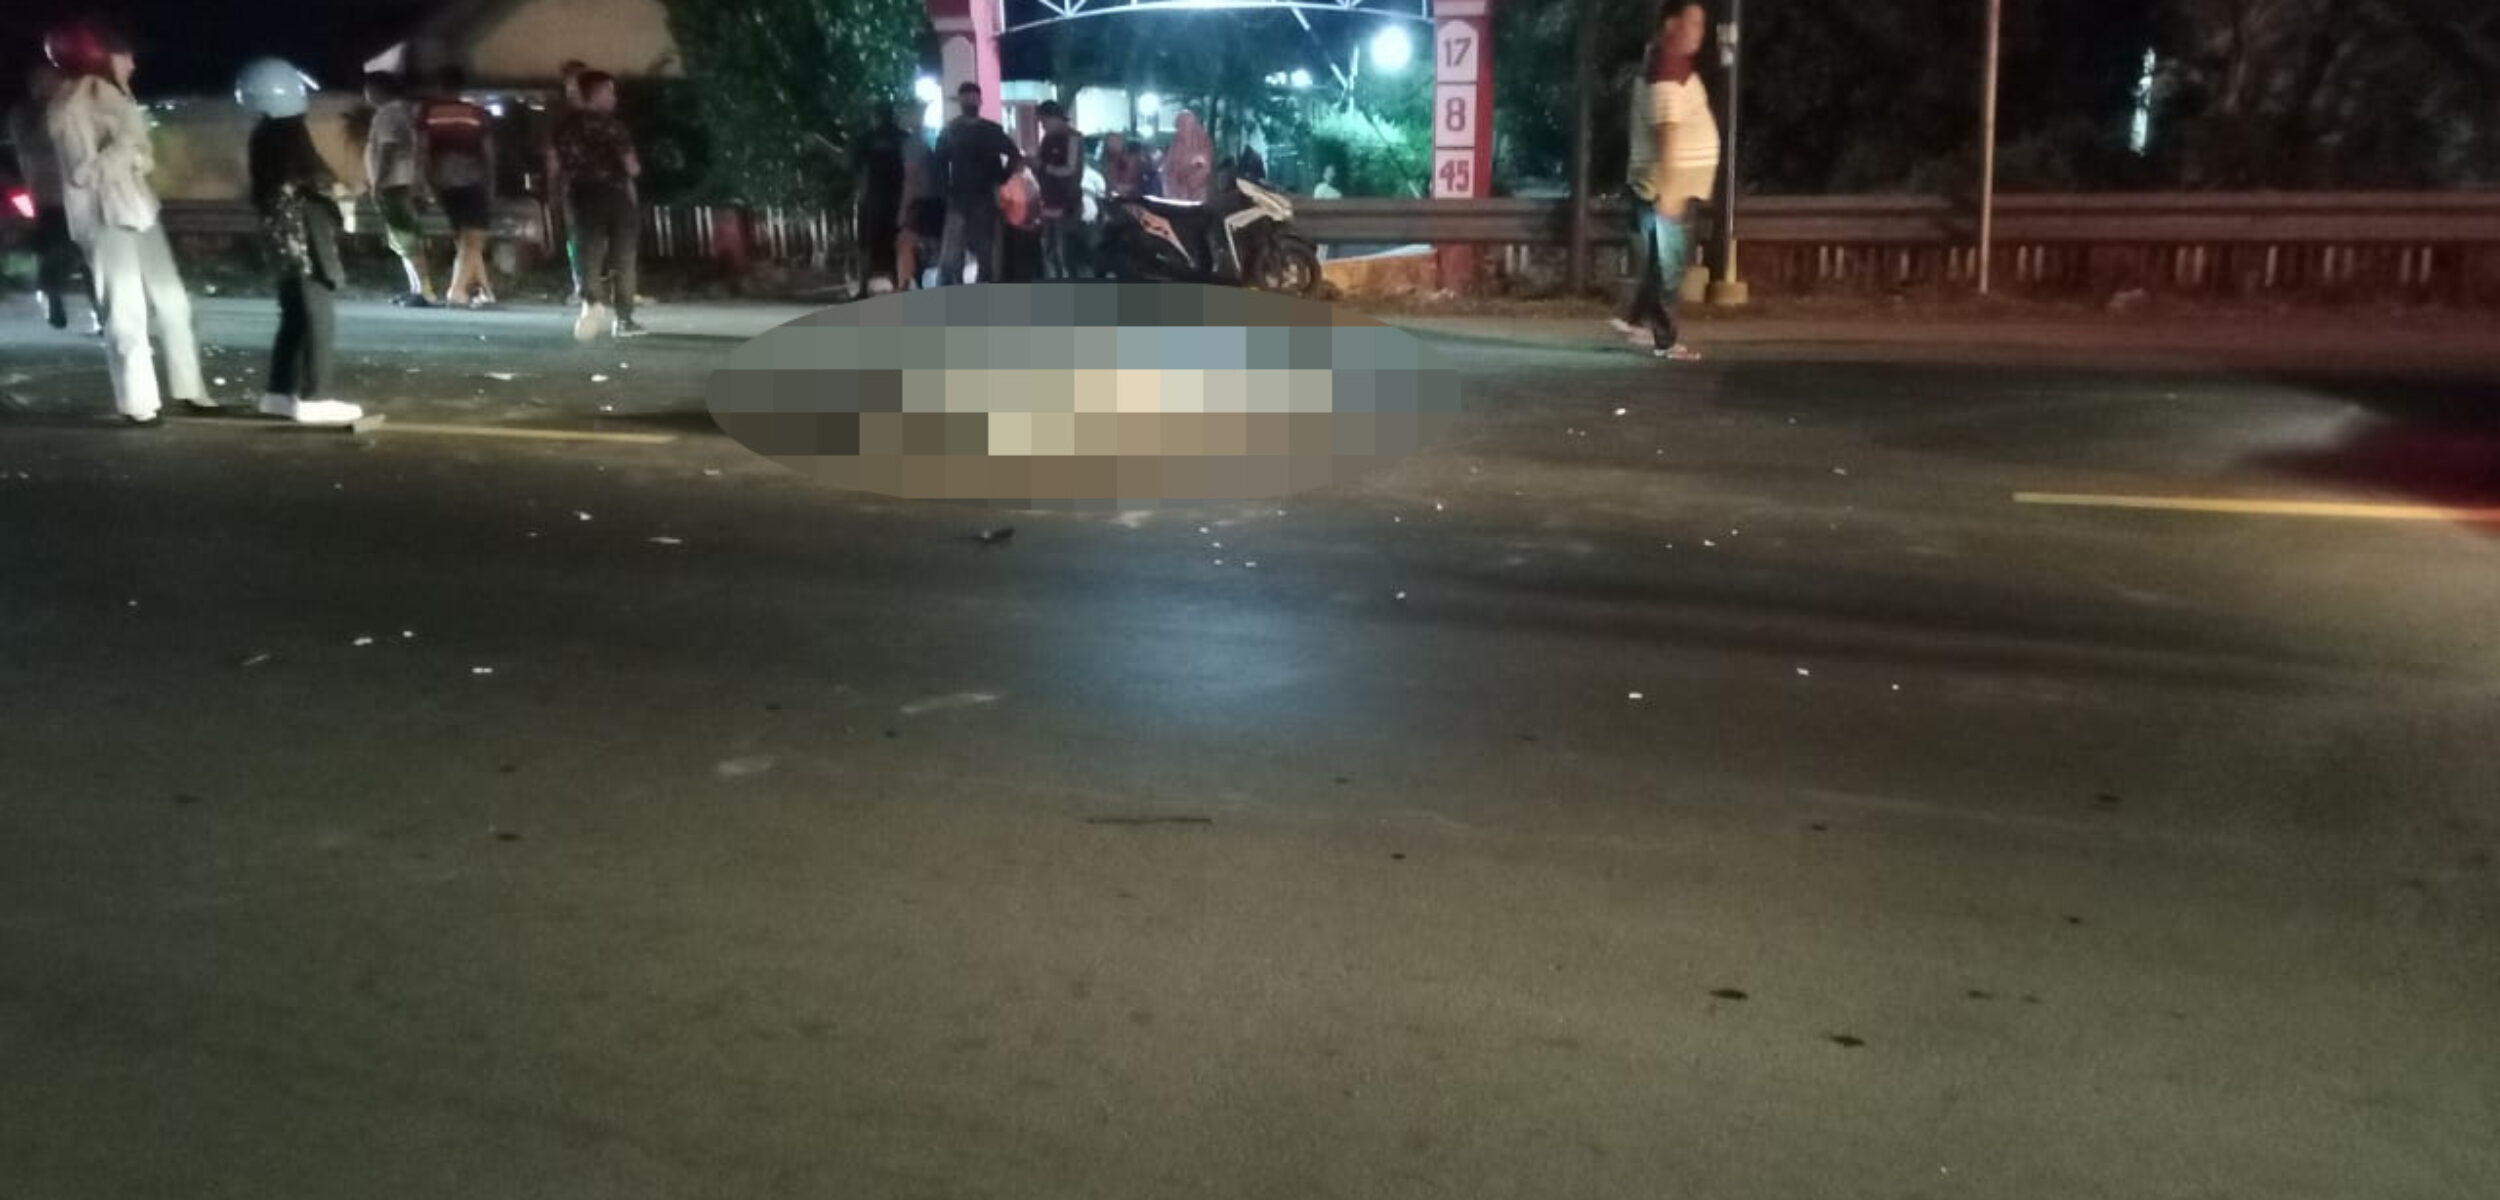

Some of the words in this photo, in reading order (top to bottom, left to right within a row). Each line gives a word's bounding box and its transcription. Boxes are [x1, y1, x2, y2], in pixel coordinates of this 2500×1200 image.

[1444, 37, 1471, 67] 17
[1445, 97, 1466, 132] 8
[1439, 159, 1469, 192] 45
